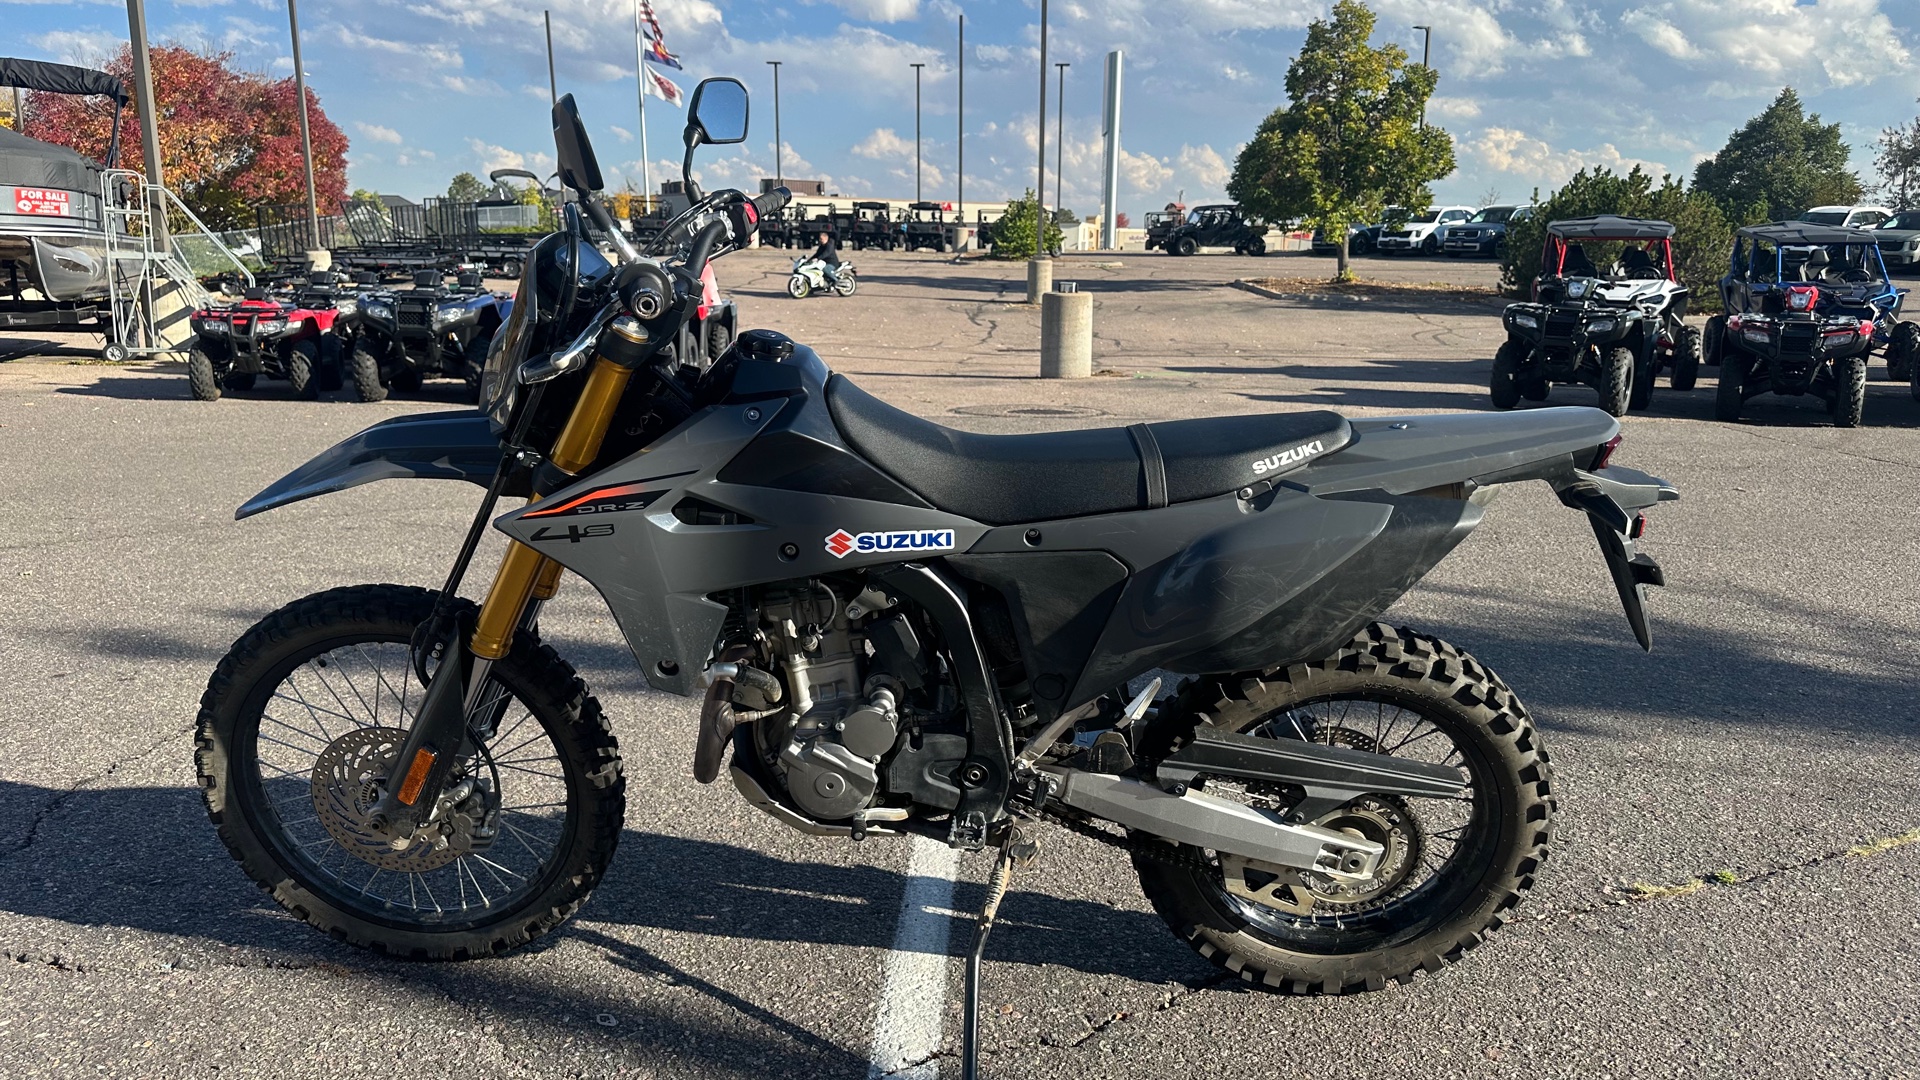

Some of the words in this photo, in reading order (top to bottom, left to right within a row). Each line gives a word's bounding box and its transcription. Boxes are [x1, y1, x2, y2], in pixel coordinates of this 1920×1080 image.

[21, 190, 43, 199] FOR
[45, 191, 66, 201] SALE
[1252, 440, 1324, 474] SUZUKI
[576, 501, 645, 514] DR-Z
[857, 532, 952, 551] SUZUKI
